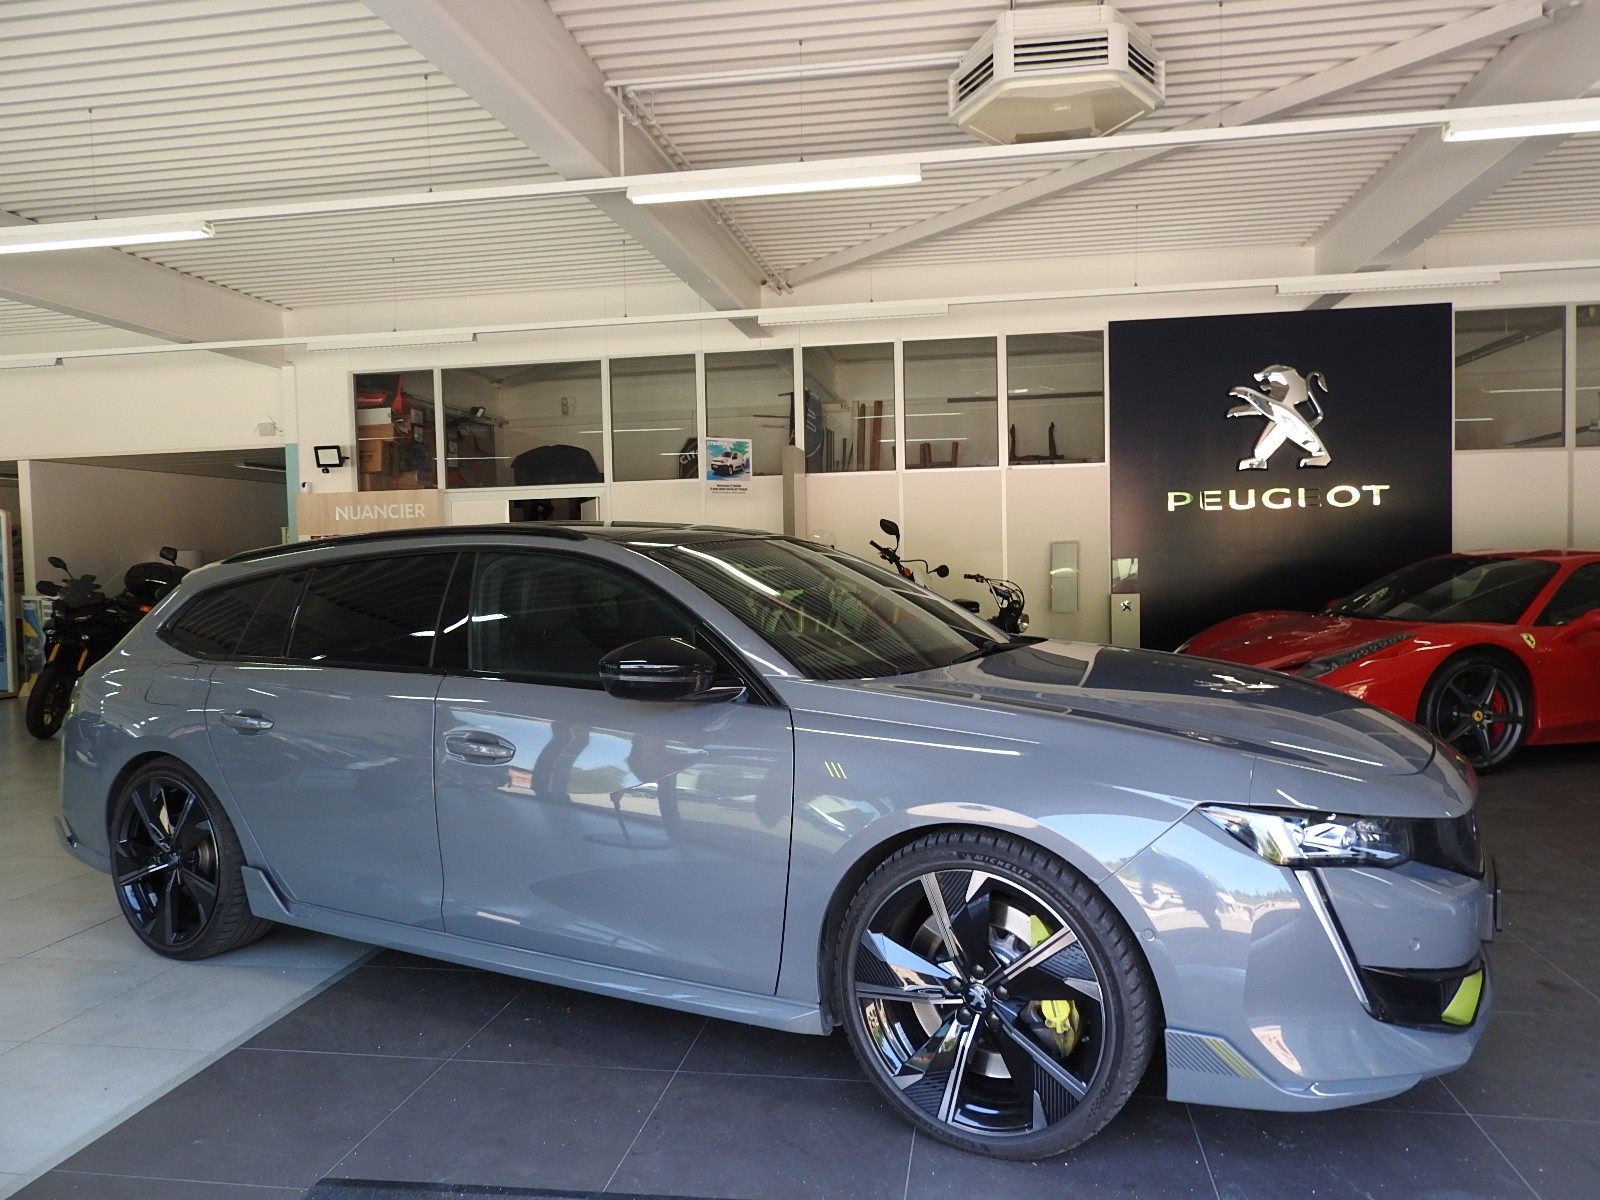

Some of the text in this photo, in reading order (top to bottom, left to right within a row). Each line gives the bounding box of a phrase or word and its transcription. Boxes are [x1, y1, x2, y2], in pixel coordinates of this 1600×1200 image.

[680, 449, 698, 464] CIT
[1167, 484, 1391, 512] PEUGEOT
[335, 503, 426, 521] NUANCIER
[974, 854, 1032, 879] MICHELIN
